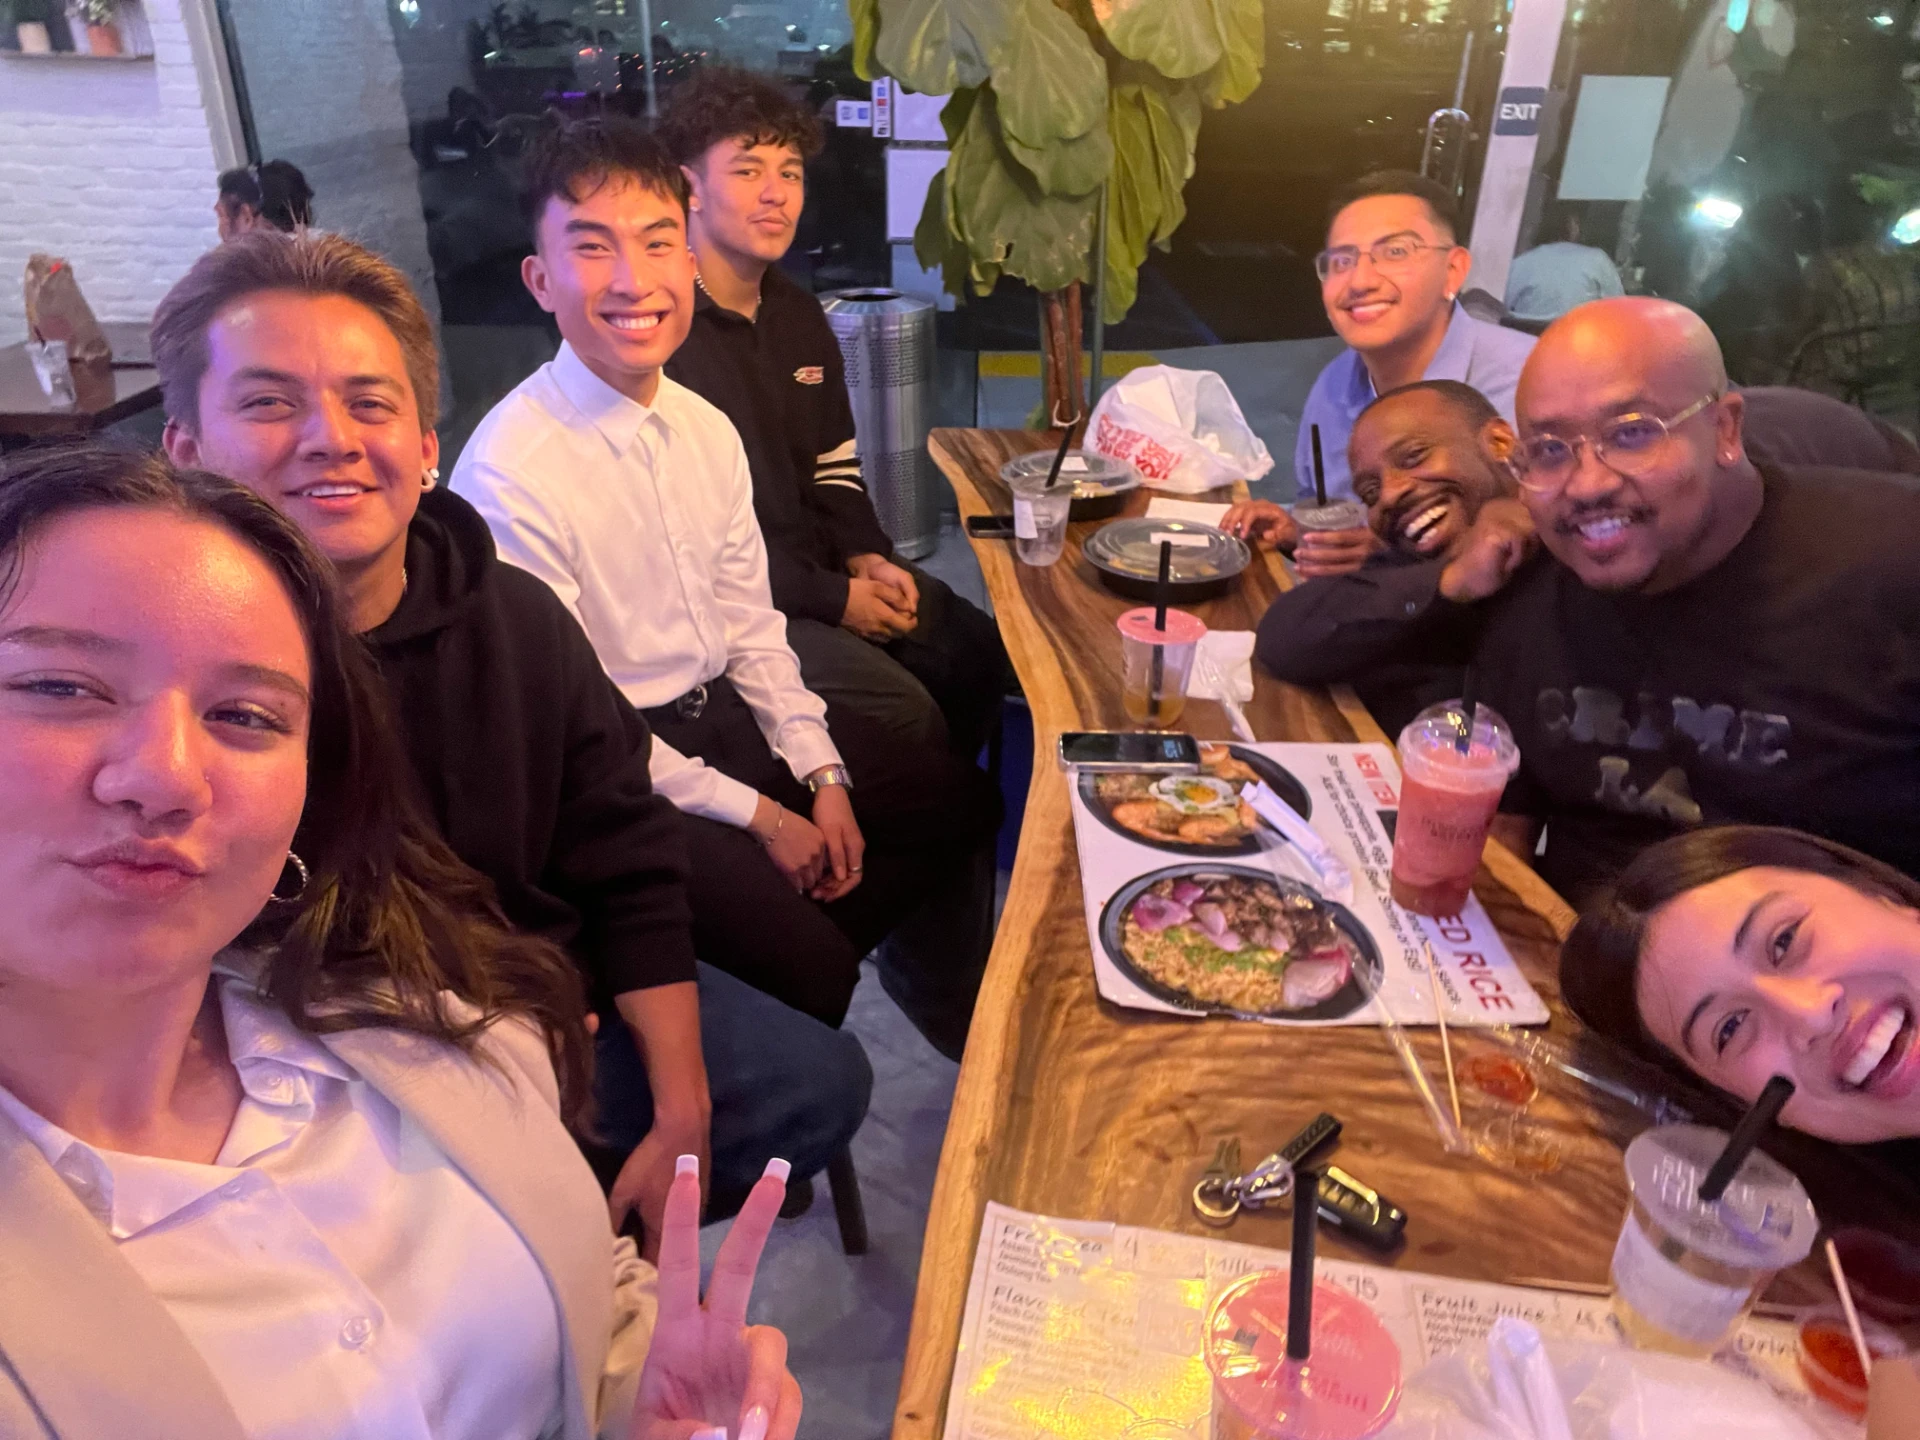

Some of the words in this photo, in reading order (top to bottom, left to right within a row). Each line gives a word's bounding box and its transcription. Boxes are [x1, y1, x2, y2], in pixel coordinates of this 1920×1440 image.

[1500, 103, 1542, 120] EXIT
[1453, 951, 1515, 1010] RICE
[1422, 1291, 1478, 1313] Fruit
